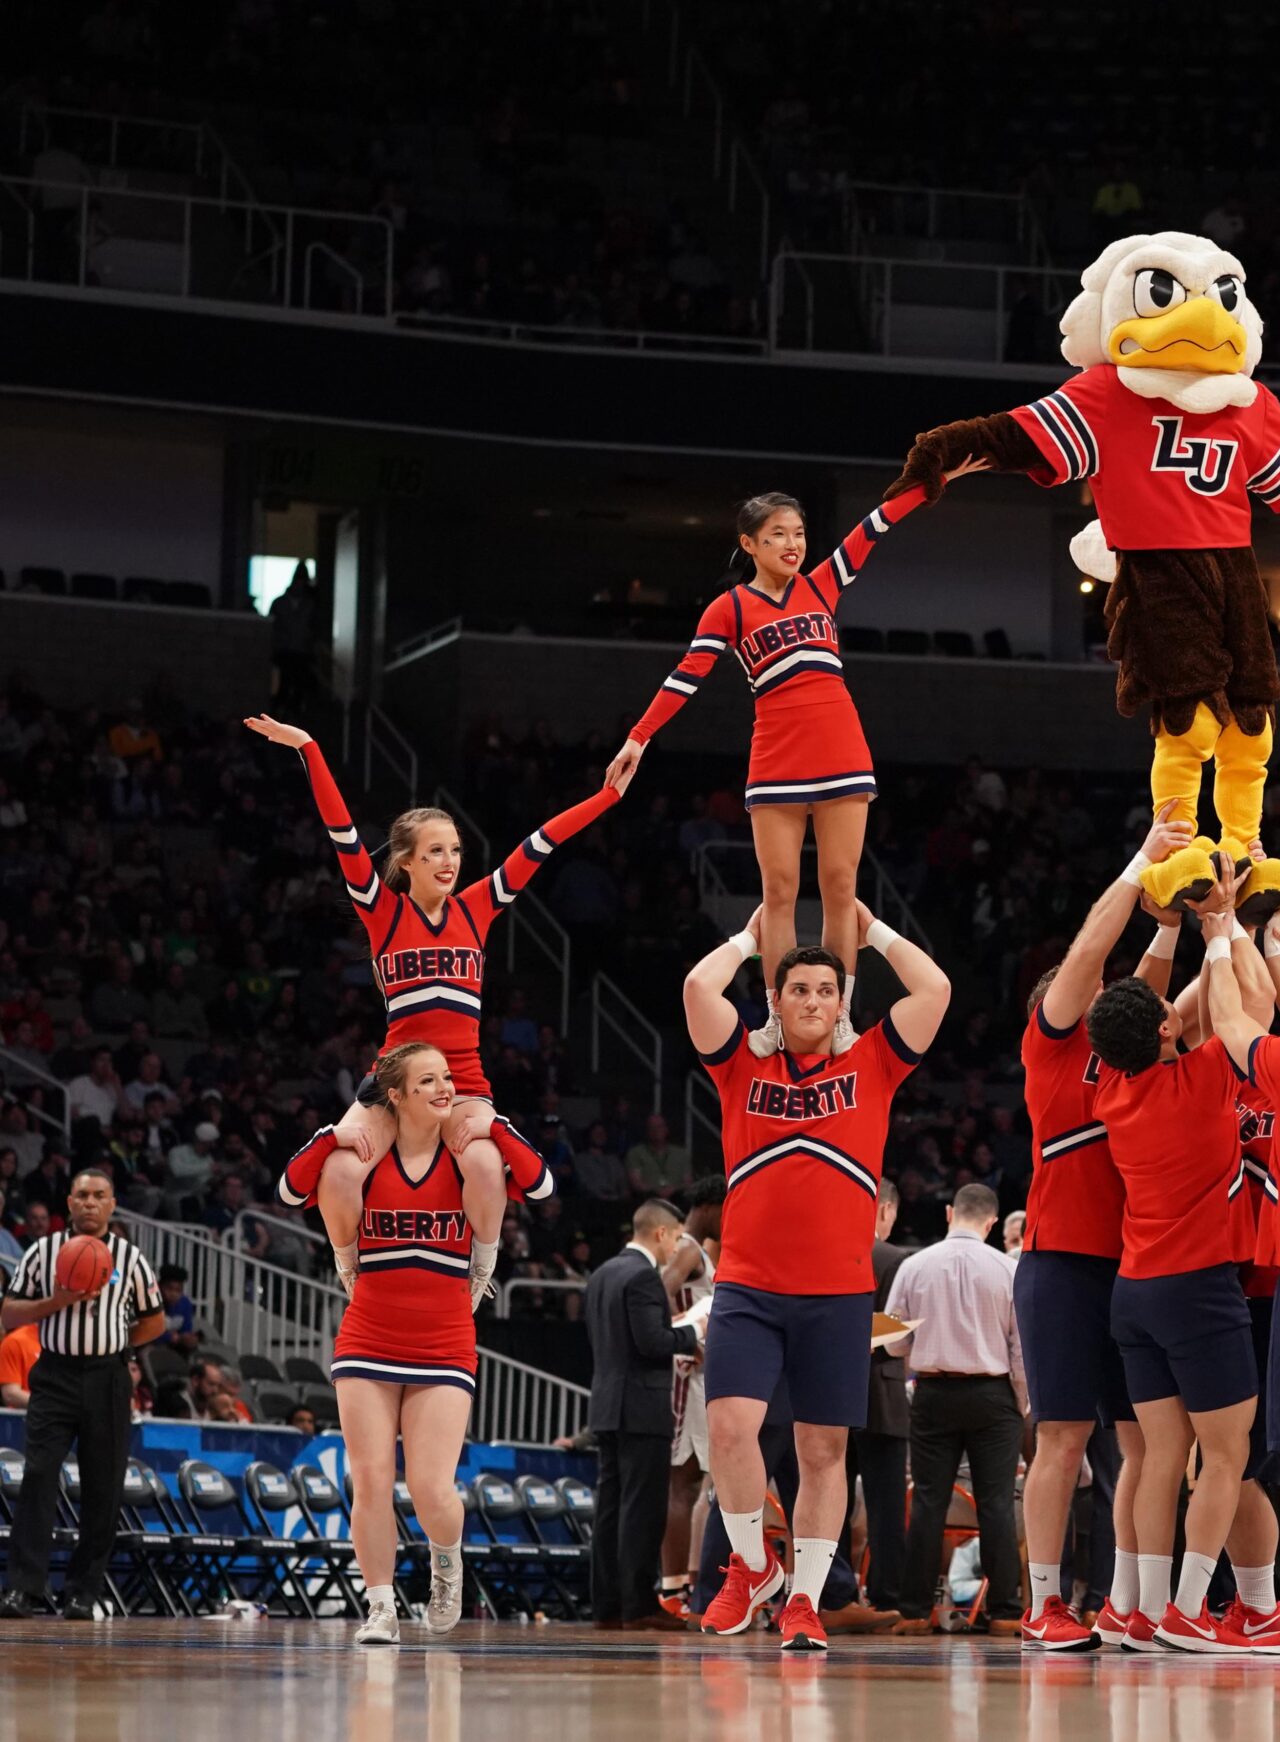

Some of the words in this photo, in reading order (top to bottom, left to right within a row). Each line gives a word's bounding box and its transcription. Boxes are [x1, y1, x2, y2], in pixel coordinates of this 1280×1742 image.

[1150, 415, 1239, 497] LU
[381, 947, 483, 986] LIBERTY
[746, 1071, 858, 1121] LIBERTY
[361, 1208, 466, 1241] LIBERTY
